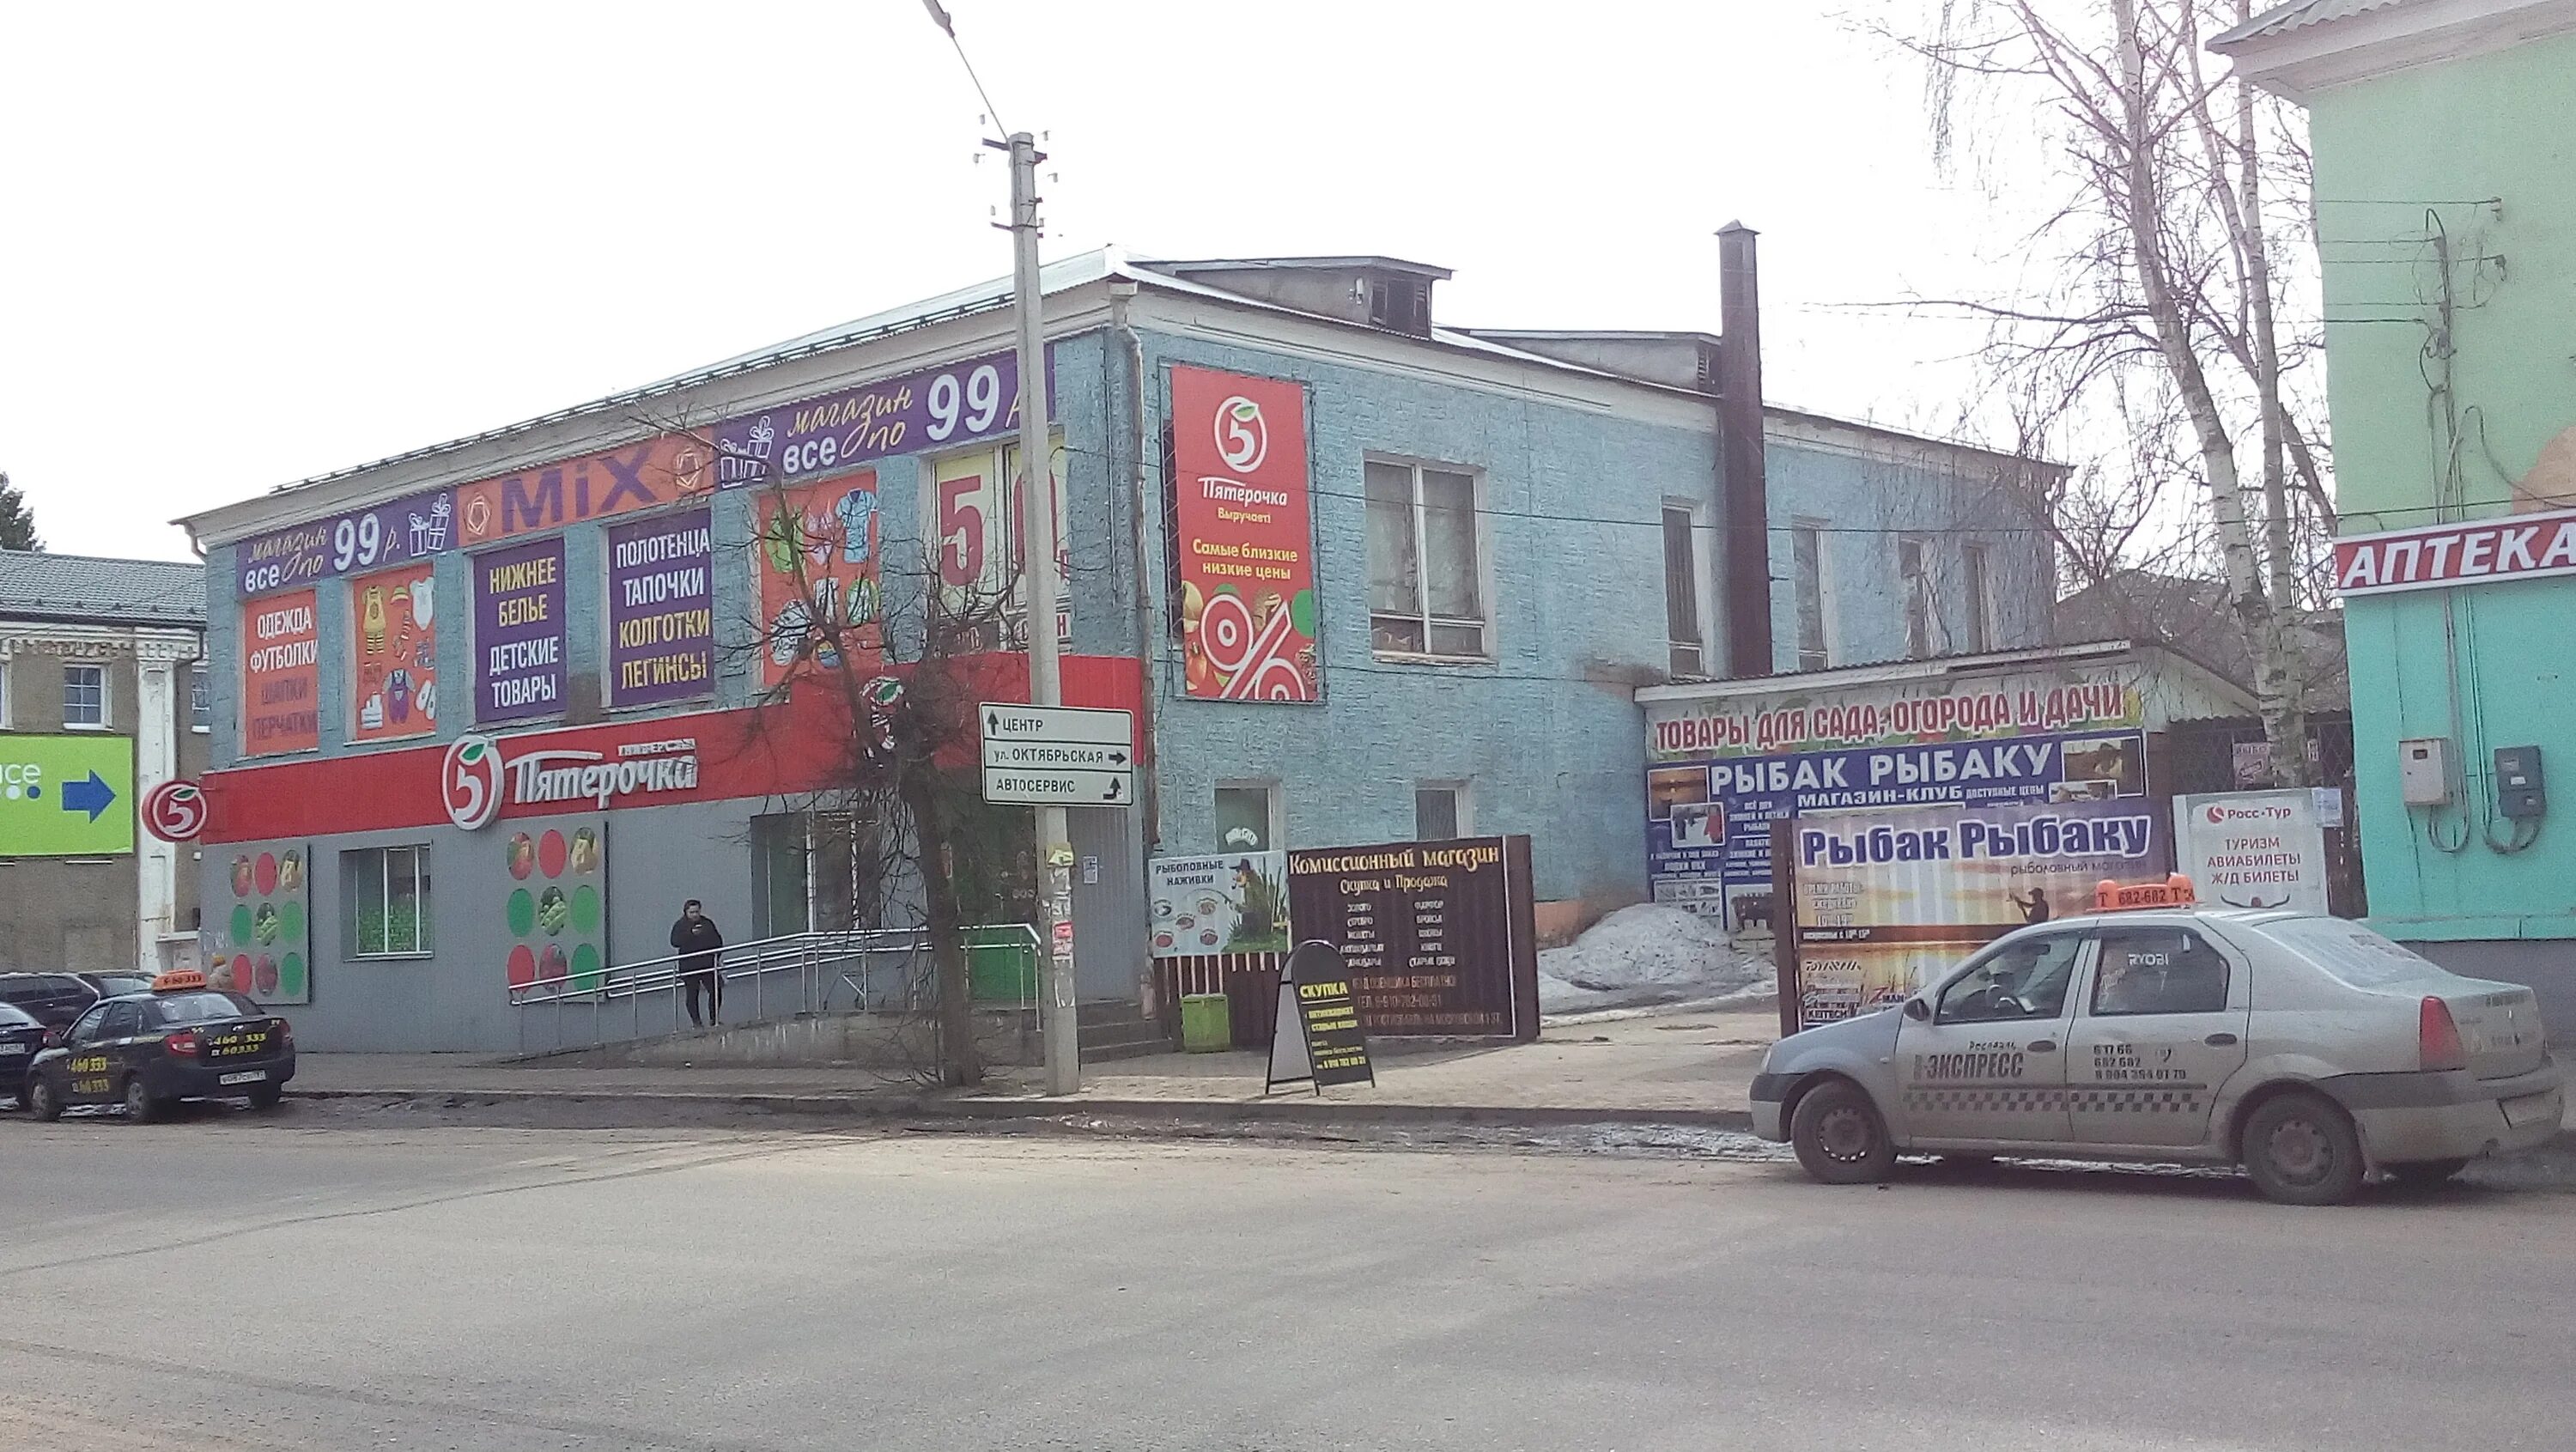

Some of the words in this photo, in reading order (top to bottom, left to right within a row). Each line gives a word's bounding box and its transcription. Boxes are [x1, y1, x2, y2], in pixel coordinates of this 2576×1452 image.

[787, 385, 913, 448] магазин
[927, 365, 999, 441] 99
[783, 436, 836, 473] все
[867, 422, 908, 453] по
[1197, 477, 1288, 507] Пятерочка
[247, 526, 328, 572] магазин
[333, 513, 380, 572] 99
[617, 527, 711, 568] ПОЛОТЕНЦА
[1193, 538, 1239, 559] Самые
[1241, 542, 1298, 562] близкие
[2340, 522, 2576, 590] АПТЕКА
[245, 564, 280, 592] все
[300, 555, 324, 578] по
[489, 556, 556, 594] НИЖНЕЕ
[623, 567, 704, 607] ТАПОЧКИ
[1202, 562, 1252, 578] низкие
[1255, 565, 1291, 581] цены
[258, 606, 312, 640] ОДЕЖДА
[498, 594, 548, 628] БЕЛЬЕ
[619, 608, 709, 649] КОЛГОТКИ
[250, 640, 319, 673] ФУТБОЛКИ
[489, 636, 558, 677] ДЕТСКИЕ
[621, 651, 707, 690] ЛЕГИНСЫ
[491, 673, 556, 708] ТОВАРЫ
[1003, 718, 1043, 732] ЦЕНТР
[1656, 714, 1749, 750] ТОВАРЫ
[1757, 709, 1807, 749] ДЛЯ
[1893, 692, 2010, 732] ОГОРОДА
[2019, 690, 2038, 726] И
[2044, 684, 2123, 729] ДАЧИ
[994, 750, 1009, 762] ул.
[1012, 748, 1103, 763] ОКТЯБРЬСКАЯ
[1710, 757, 1850, 796] РЫБАК
[1869, 743, 2052, 787] РЫБАКУ
[0, 763, 41, 785] ce
[505, 750, 699, 810] Пятерочка
[996, 778, 1075, 793] АВТОСЕРВИС
[1798, 786, 1962, 808] МАГАЗИН-КЛУБ
[1801, 825, 1951, 867] Рыбак
[1958, 815, 2151, 859] Рыбаку
[2225, 837, 2280, 850] ТУРИЗМ
[1156, 860, 1224, 874] РЫБОЛОВНЫЕ
[1289, 848, 1415, 875] Комиссионный
[1422, 846, 1499, 872] магазин
[2011, 861, 2088, 878] рыболовный
[2207, 853, 2300, 868] АВИАБИЛЕТЫ
[2211, 872, 2239, 885] Ж/Д
[2244, 870, 2299, 884] БИЛЕТЫ
[1167, 874, 1214, 886] НАЖИВКИ
[1340, 878, 1380, 896] Скупка
[1383, 878, 1391, 890] и
[2128, 953, 2169, 966] RYOBI
[1299, 981, 1349, 998] СКУПКА
